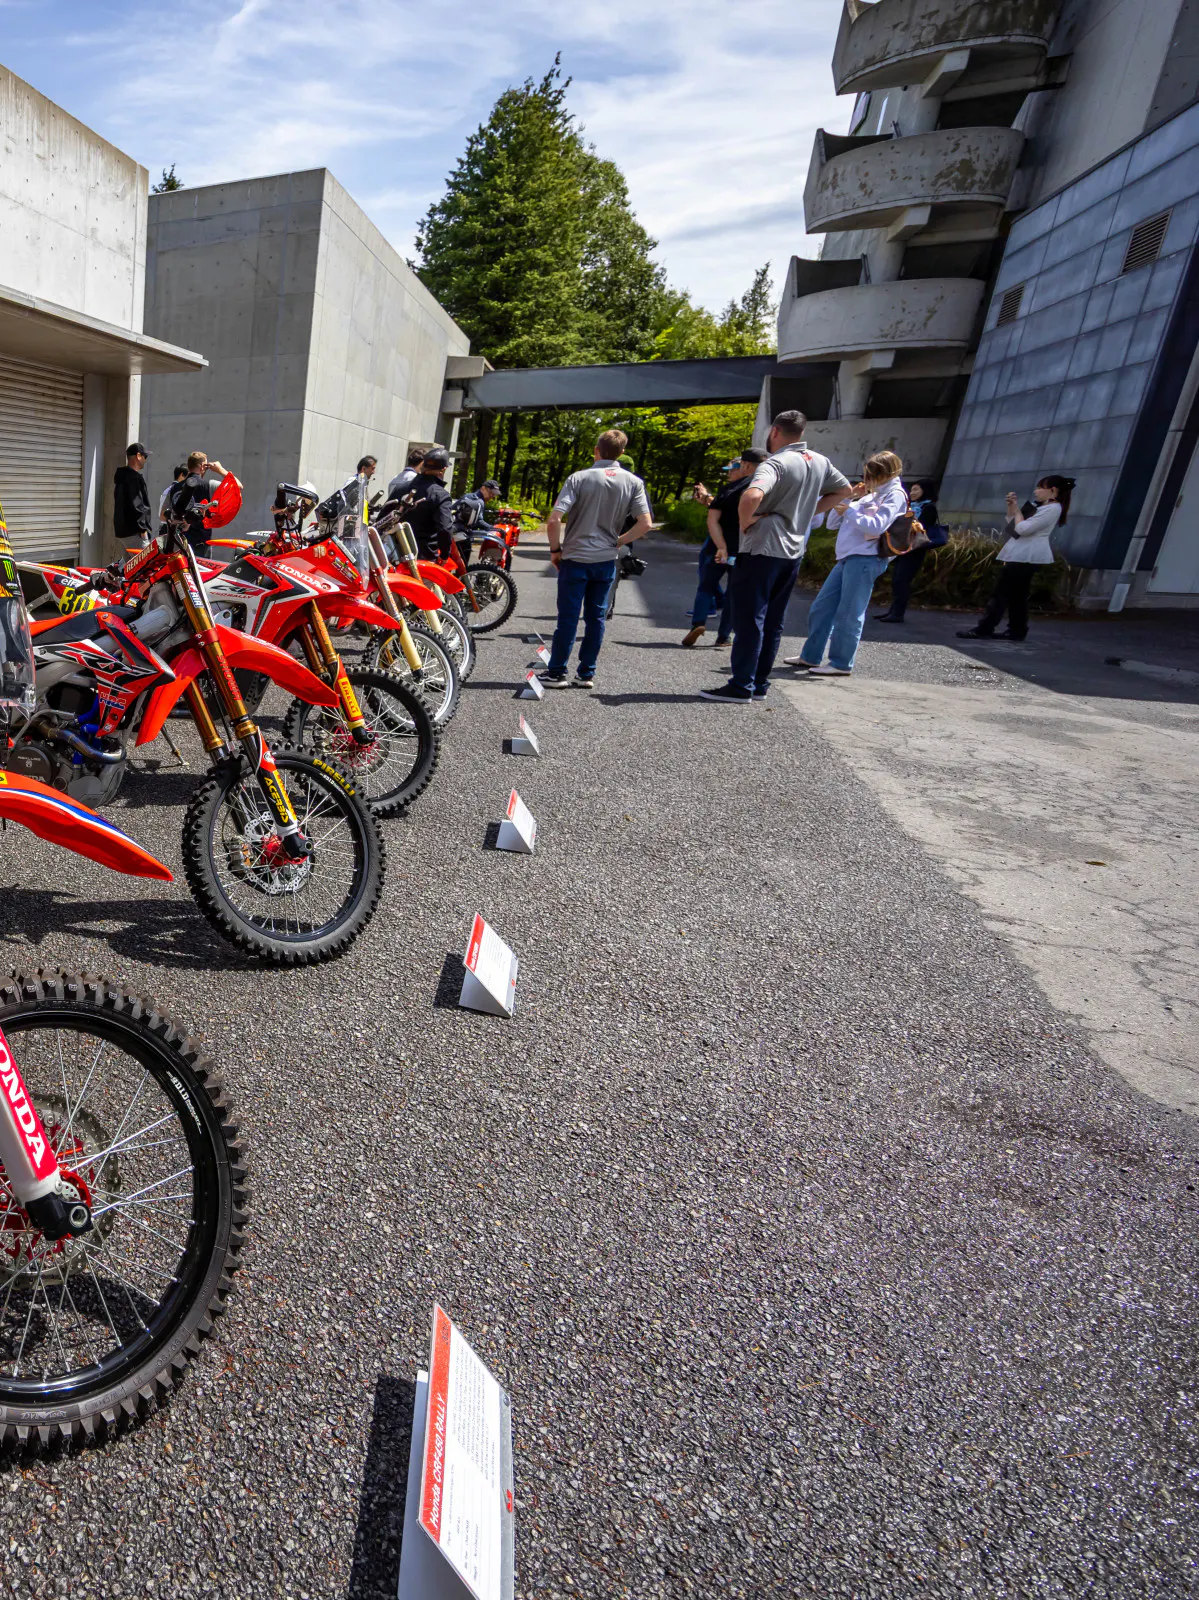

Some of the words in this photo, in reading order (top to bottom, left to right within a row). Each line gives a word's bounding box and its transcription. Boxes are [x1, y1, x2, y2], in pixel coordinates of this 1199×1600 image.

[126, 544, 155, 573] RENTHAL
[273, 561, 325, 590] HONDA
[216, 654, 242, 701] SHOWA
[341, 681, 359, 714] PIRELLI
[312, 758, 356, 797] PIRELLI
[435, 1393, 447, 1434] RALLY
[433, 1433, 445, 1483] CRF450
[429, 1484, 442, 1529] Honda
